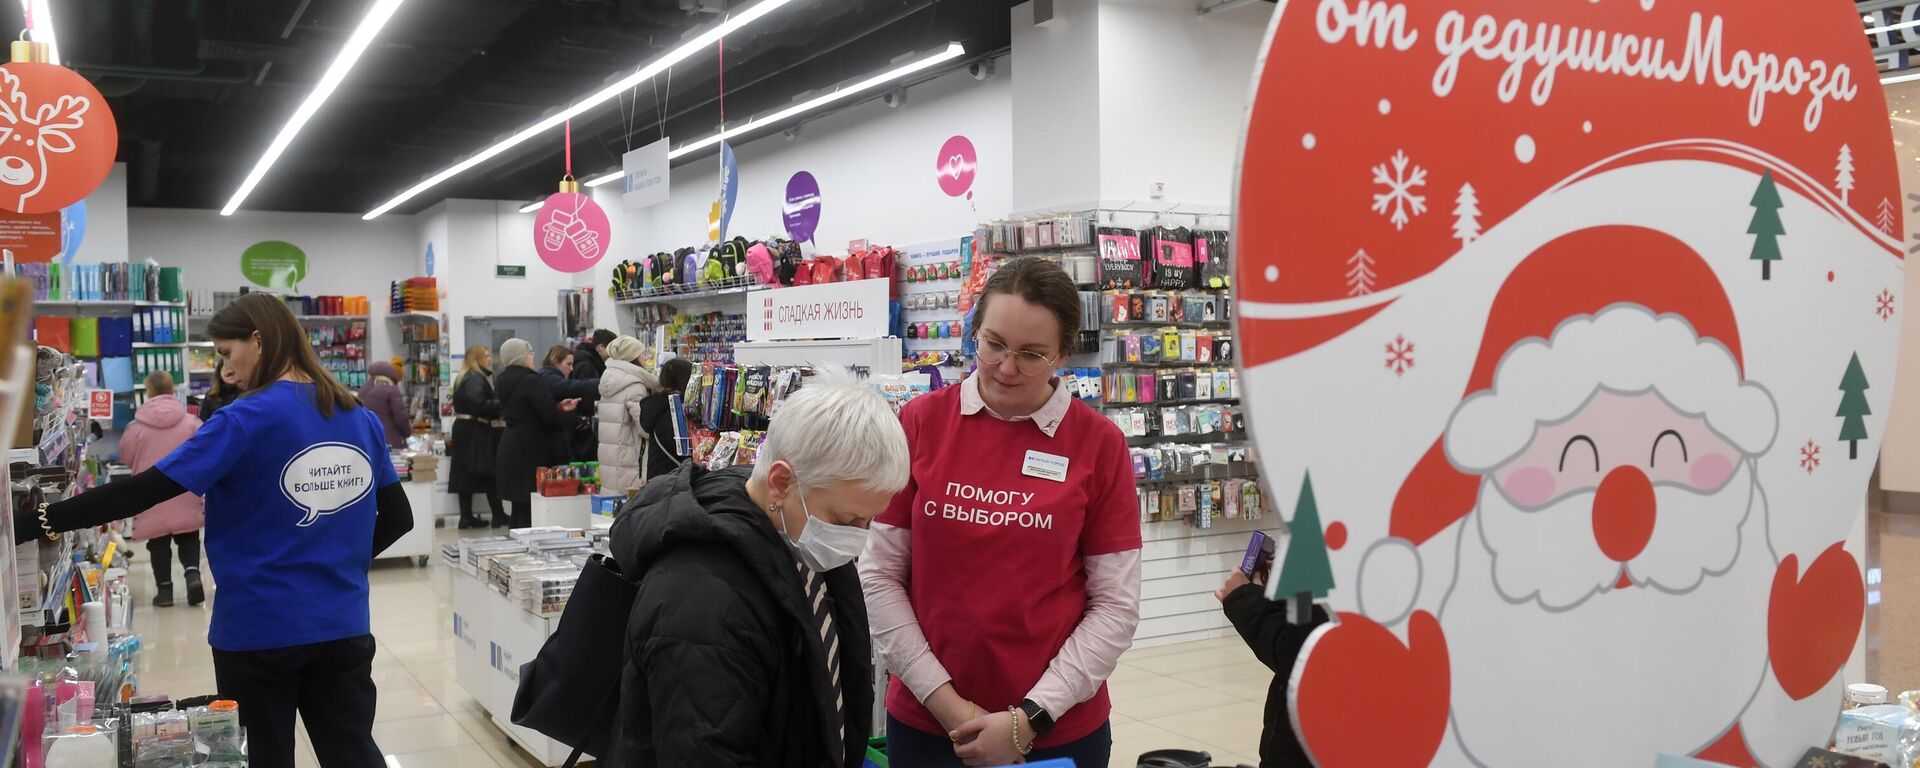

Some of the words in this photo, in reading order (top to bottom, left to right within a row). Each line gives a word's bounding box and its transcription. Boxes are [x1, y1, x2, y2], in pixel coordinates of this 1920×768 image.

[1316, 0, 1418, 51] от
[778, 303, 821, 326] СЛАДКАЯ
[823, 300, 864, 320] ЖИЗНЬ
[309, 464, 352, 478] ЧИТАЙТЕ
[294, 480, 335, 493] БОЛЬШЕ
[337, 476, 364, 489] КНИГ!
[945, 481, 1035, 506] ПОМОГУ
[924, 500, 937, 517] С
[942, 503, 1053, 530] ВЫБОРОМ
